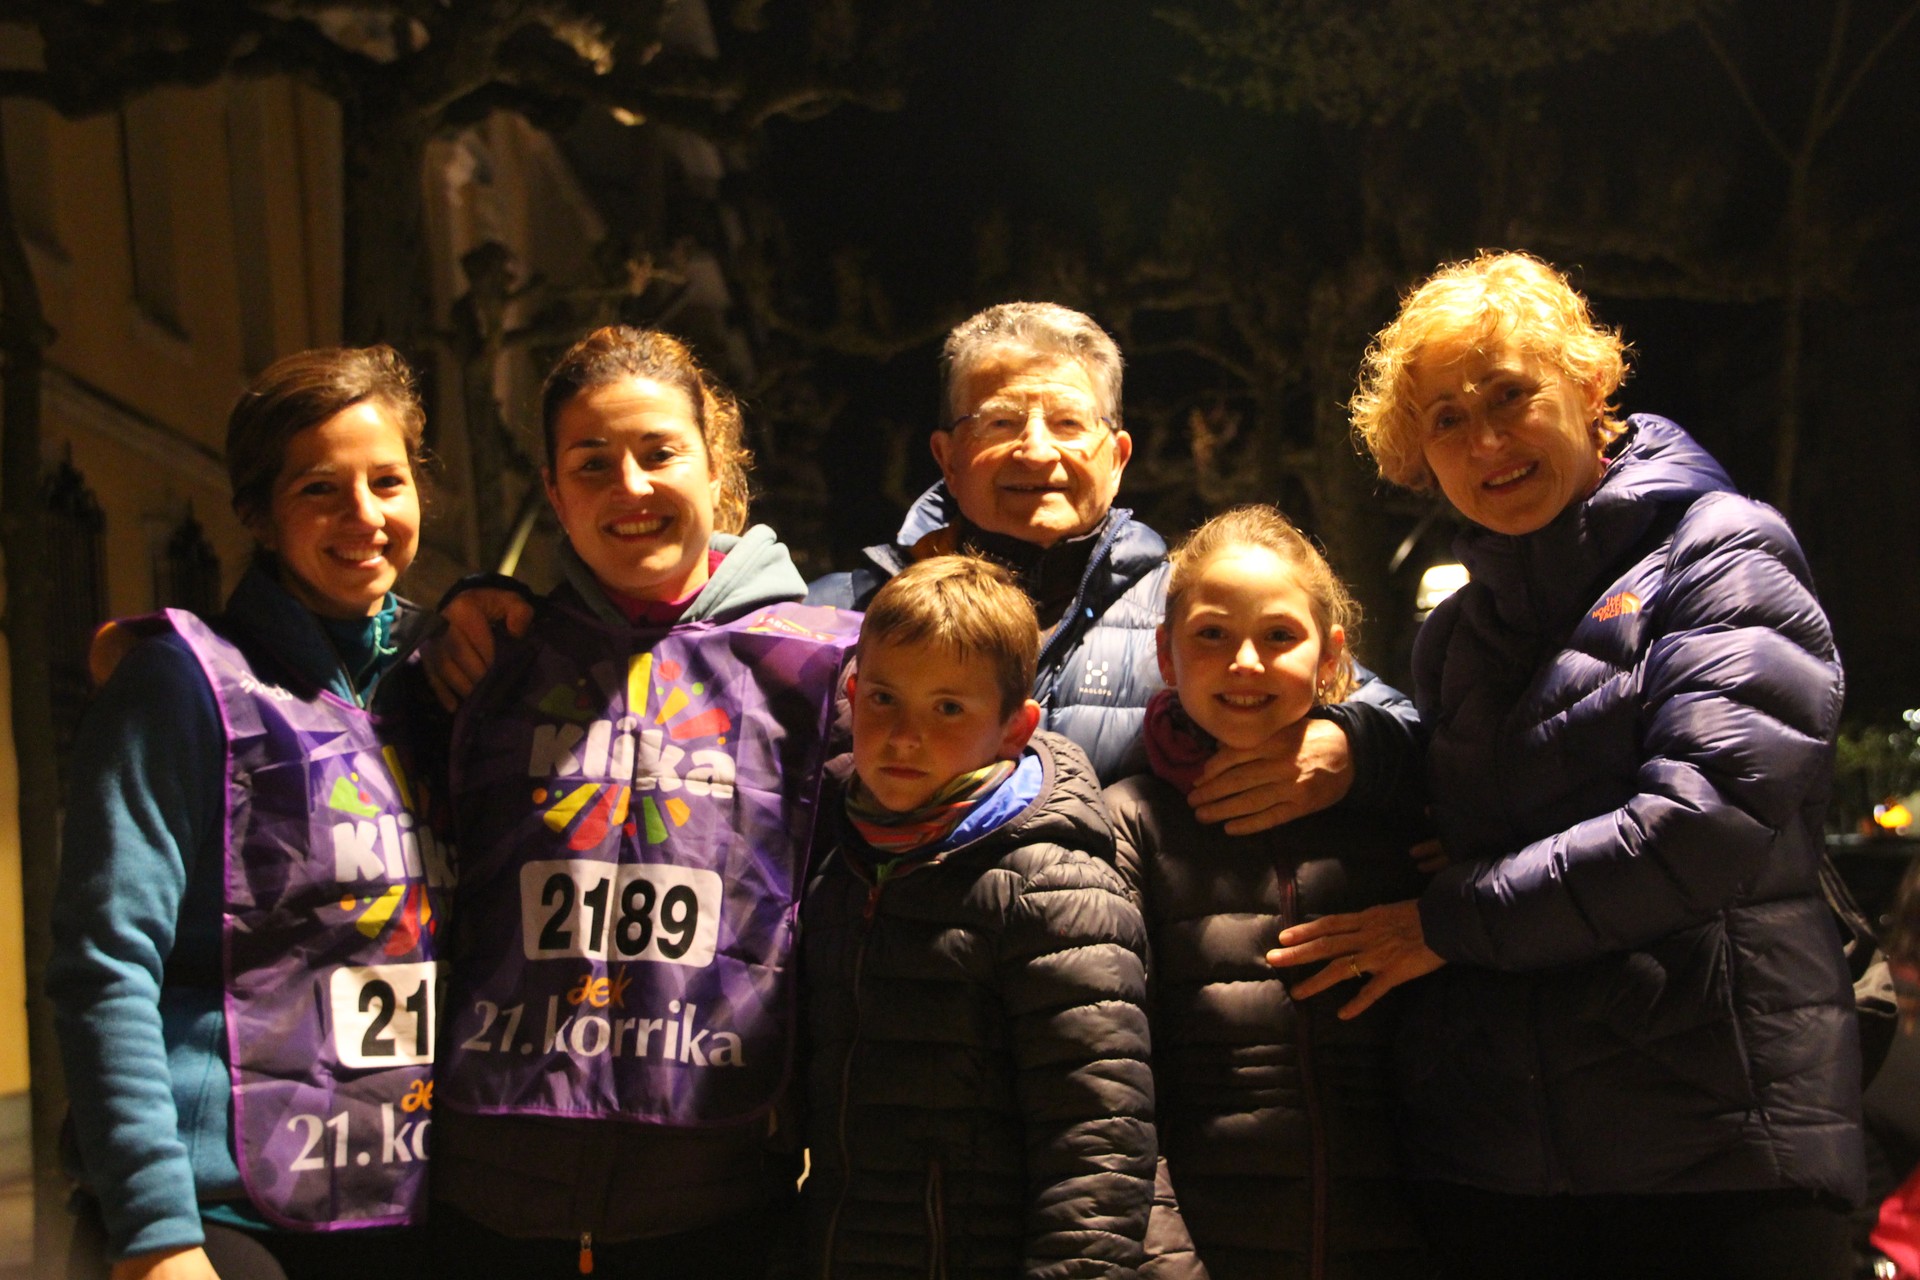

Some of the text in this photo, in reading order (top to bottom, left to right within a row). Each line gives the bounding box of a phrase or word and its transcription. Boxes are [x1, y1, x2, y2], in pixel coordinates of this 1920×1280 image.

[528, 716, 736, 799] Klika
[332, 812, 459, 889] Klik
[538, 872, 699, 960] 2189
[358, 979, 429, 1057] 21
[566, 963, 633, 1009] aek
[460, 995, 747, 1067] 21. korrika
[286, 1110, 371, 1172] 21.
